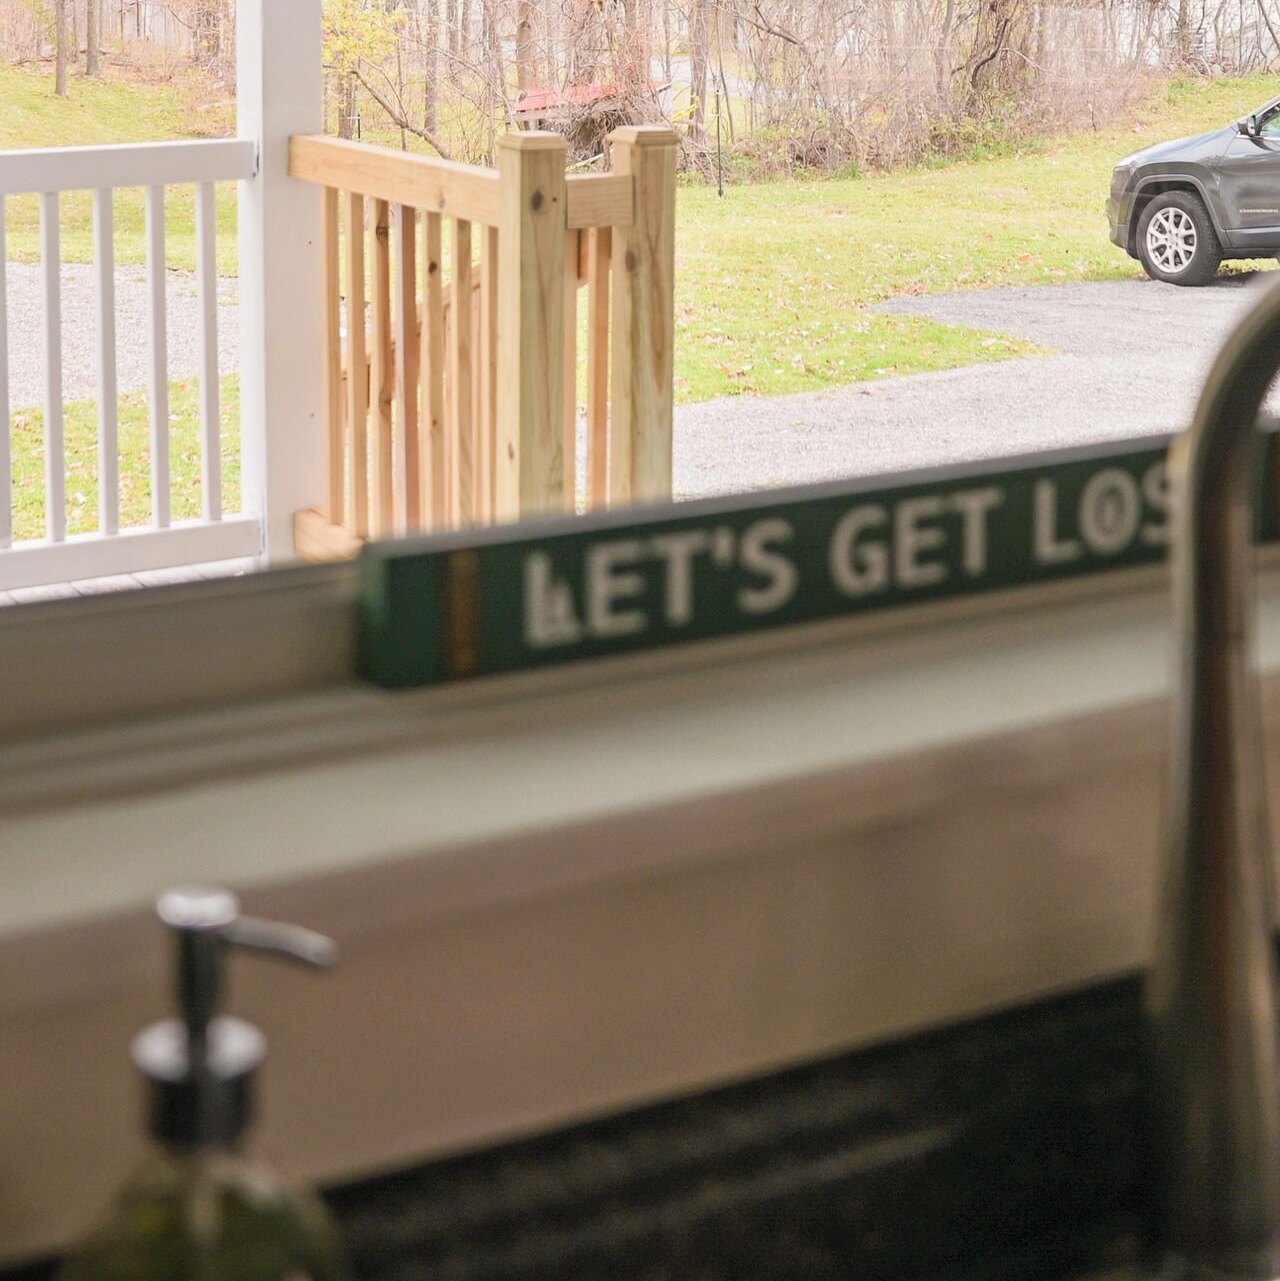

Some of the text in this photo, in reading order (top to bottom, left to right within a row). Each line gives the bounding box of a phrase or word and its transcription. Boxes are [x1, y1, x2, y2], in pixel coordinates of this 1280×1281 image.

[522, 463, 1173, 649] LET'S GET LOS
